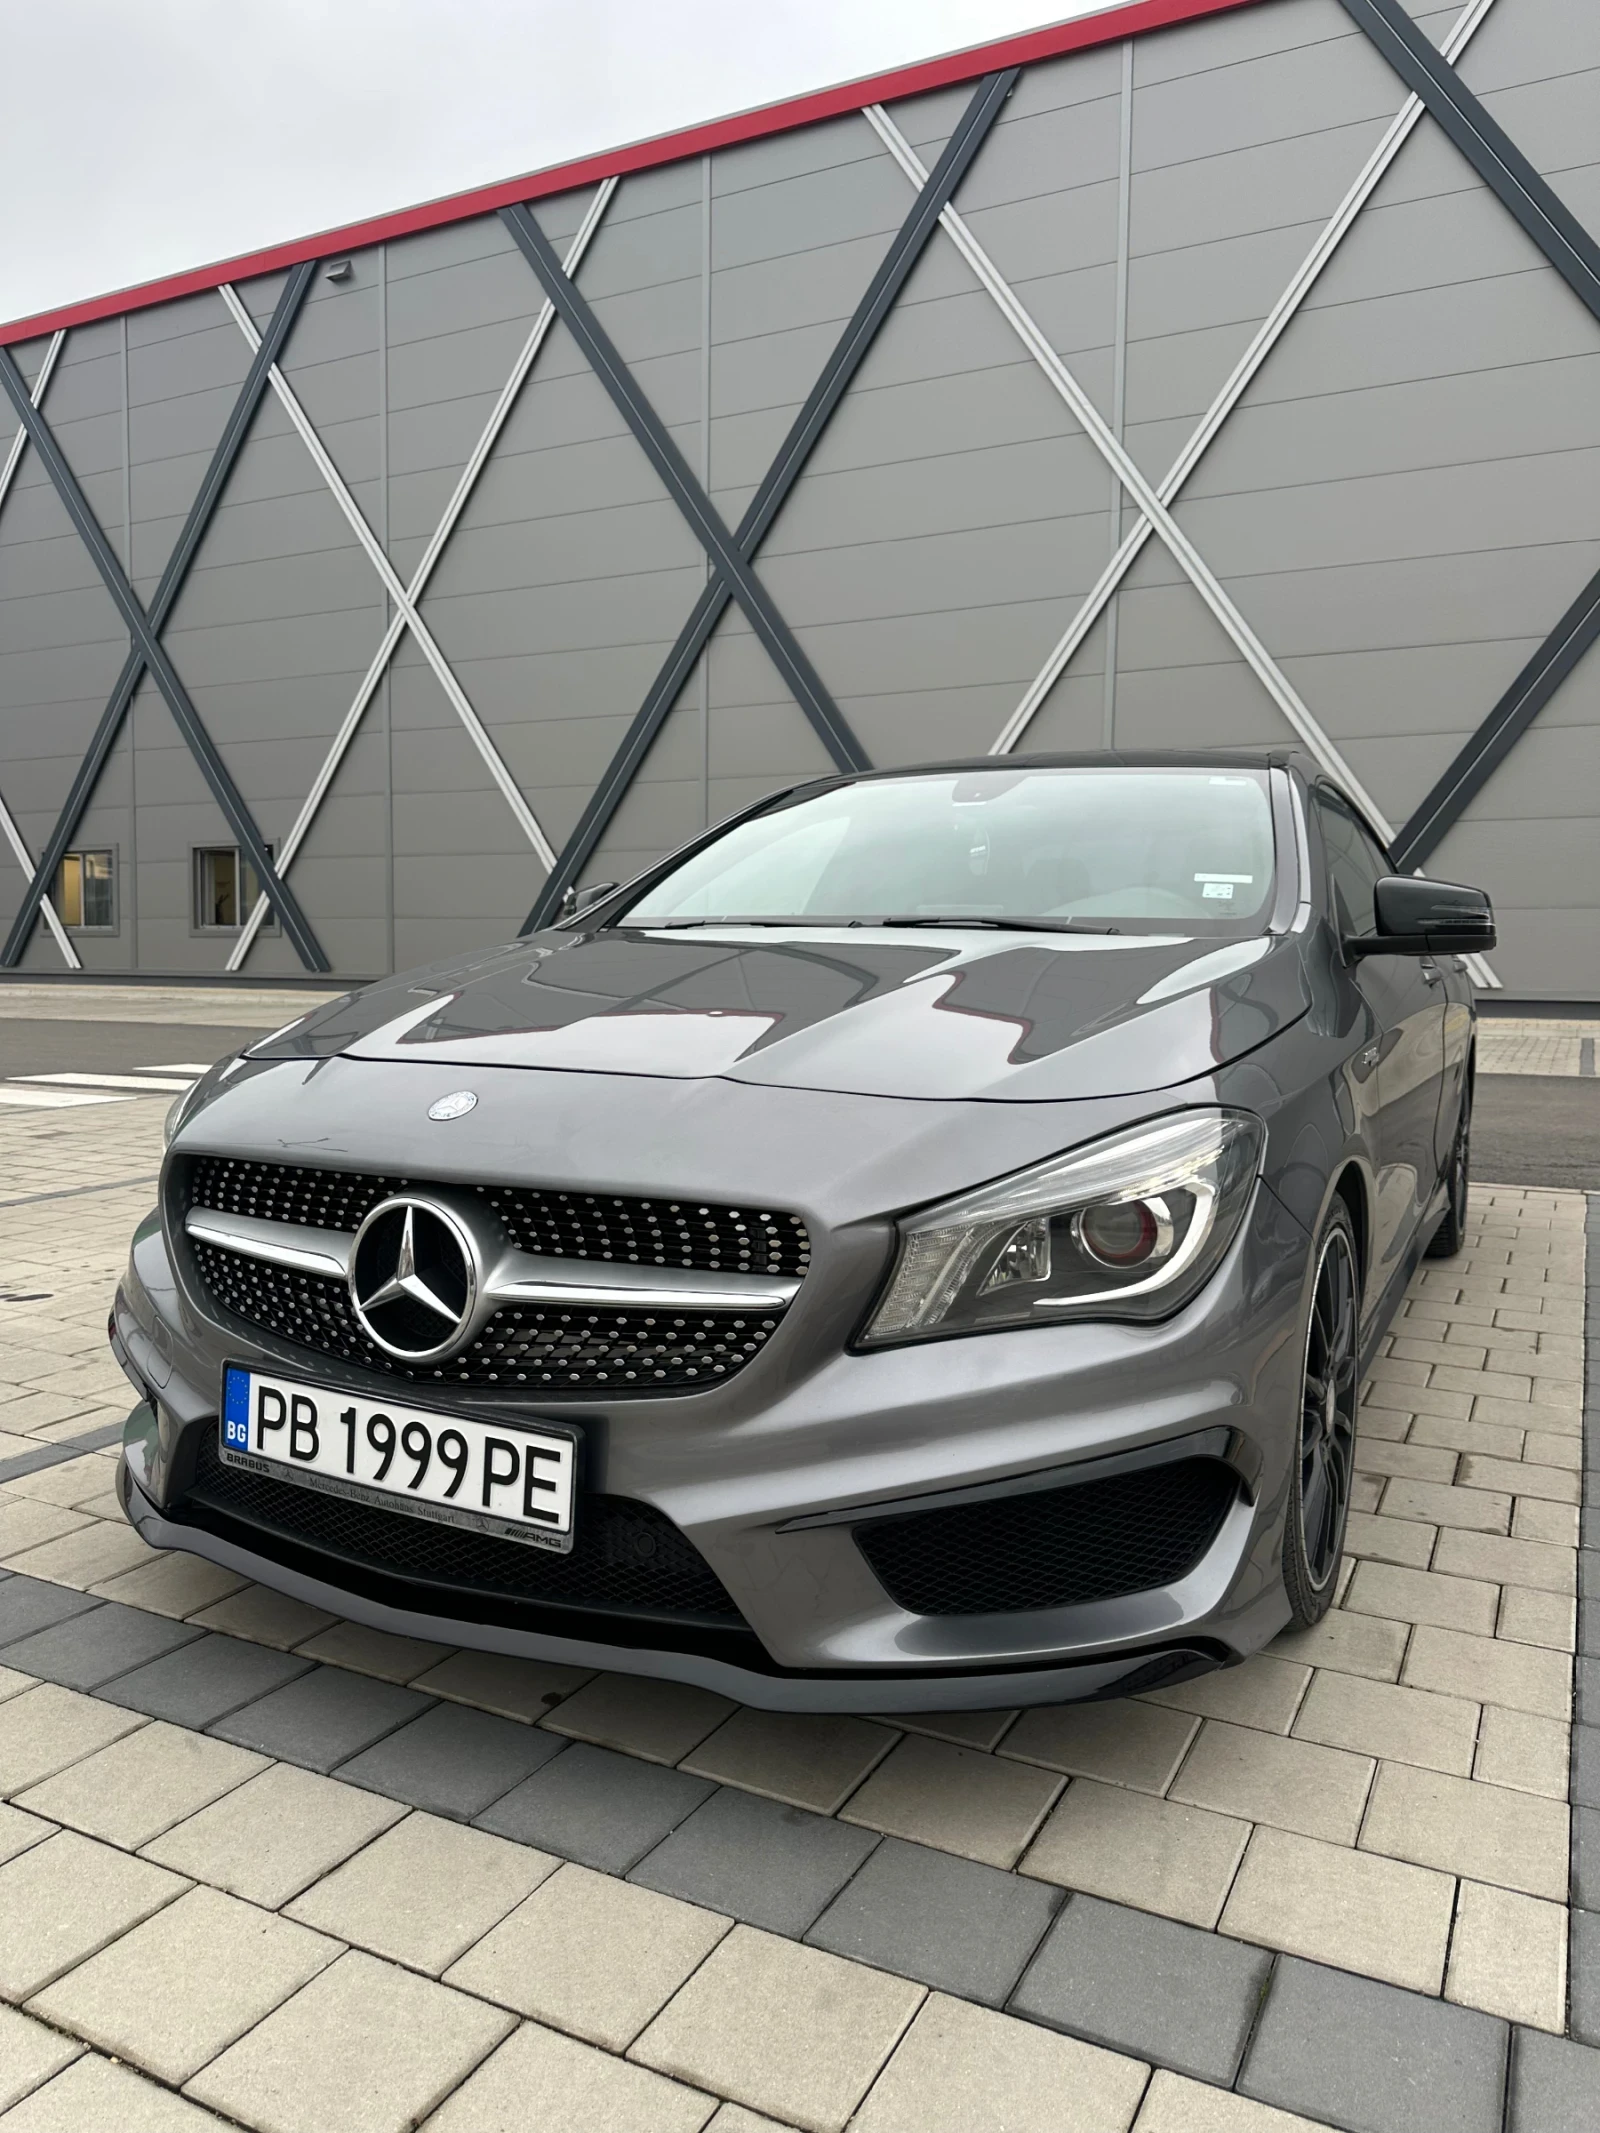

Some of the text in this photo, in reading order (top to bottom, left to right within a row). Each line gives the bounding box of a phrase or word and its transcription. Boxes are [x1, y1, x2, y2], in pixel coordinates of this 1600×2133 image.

[227, 1420, 247, 1443] BG
[226, 1453, 270, 1473] BRABUS
[257, 1385, 562, 1524] PB 1999 PE
[309, 1478, 371, 1503] Mercedes-Benz
[417, 1505, 456, 1524] Stuttgart
